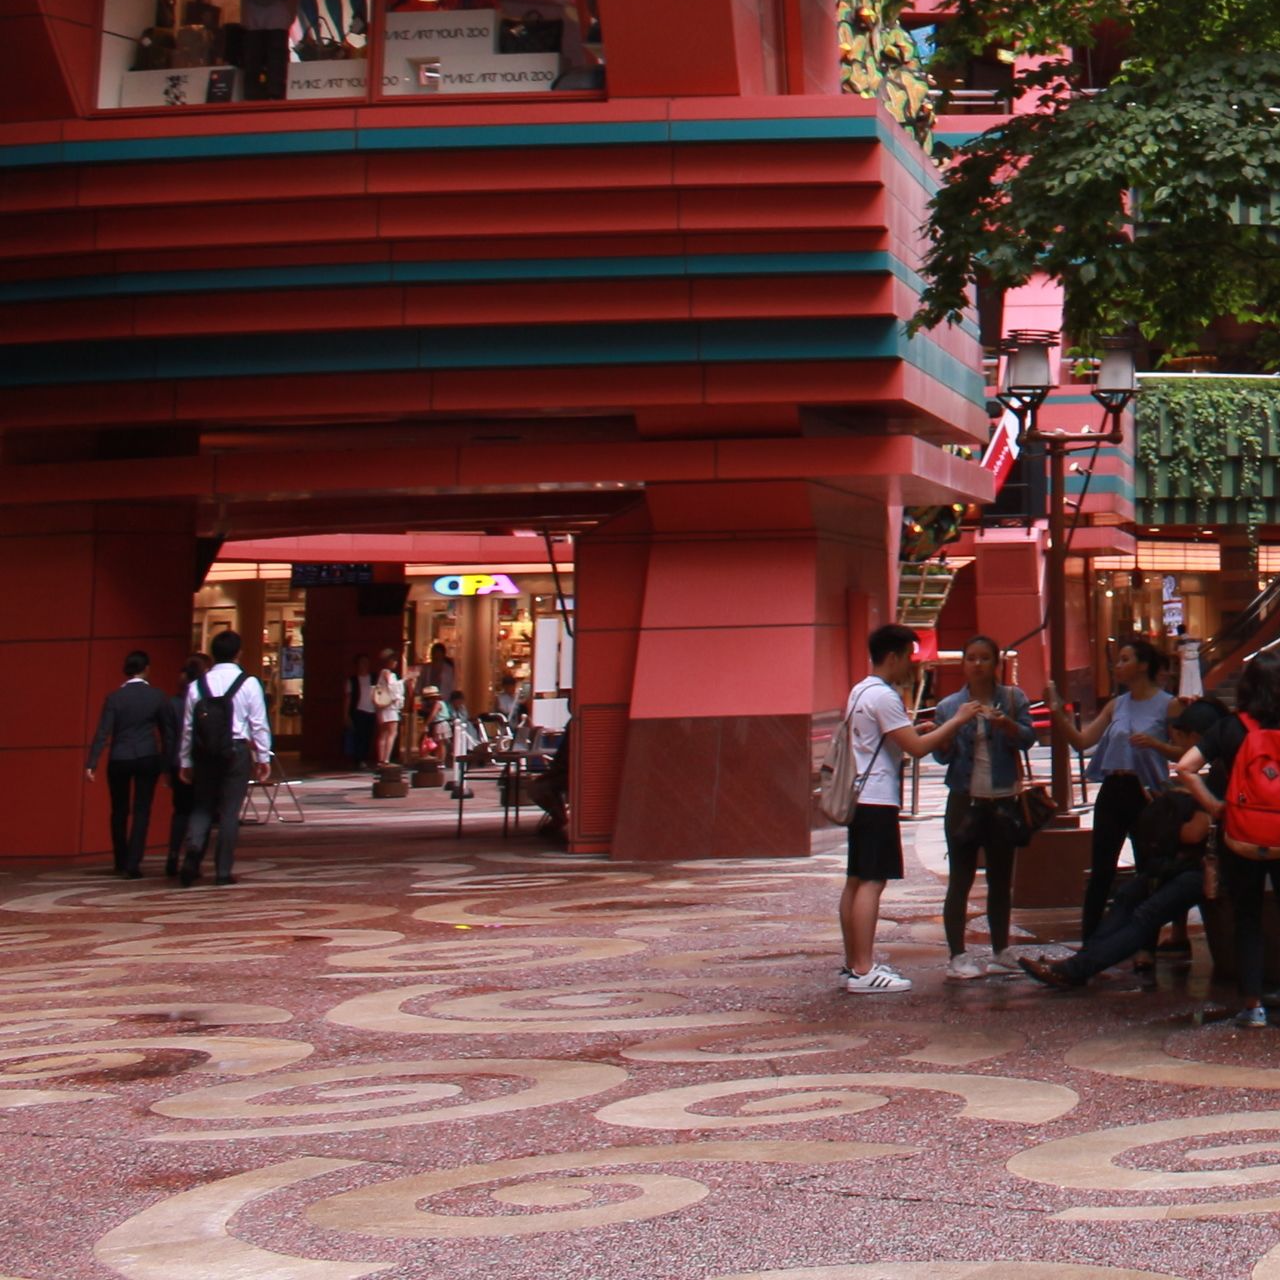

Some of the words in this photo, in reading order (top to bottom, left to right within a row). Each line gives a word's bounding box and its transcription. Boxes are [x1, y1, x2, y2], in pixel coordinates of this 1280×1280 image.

[435, 28, 464, 39] YOUR
[345, 77, 367, 88] YOU
[382, 76, 400, 86] OO
[443, 73, 474, 84] MAKE
[475, 72, 498, 83] ART
[499, 71, 528, 82] YOUR
[433, 573, 521, 596] OPA
